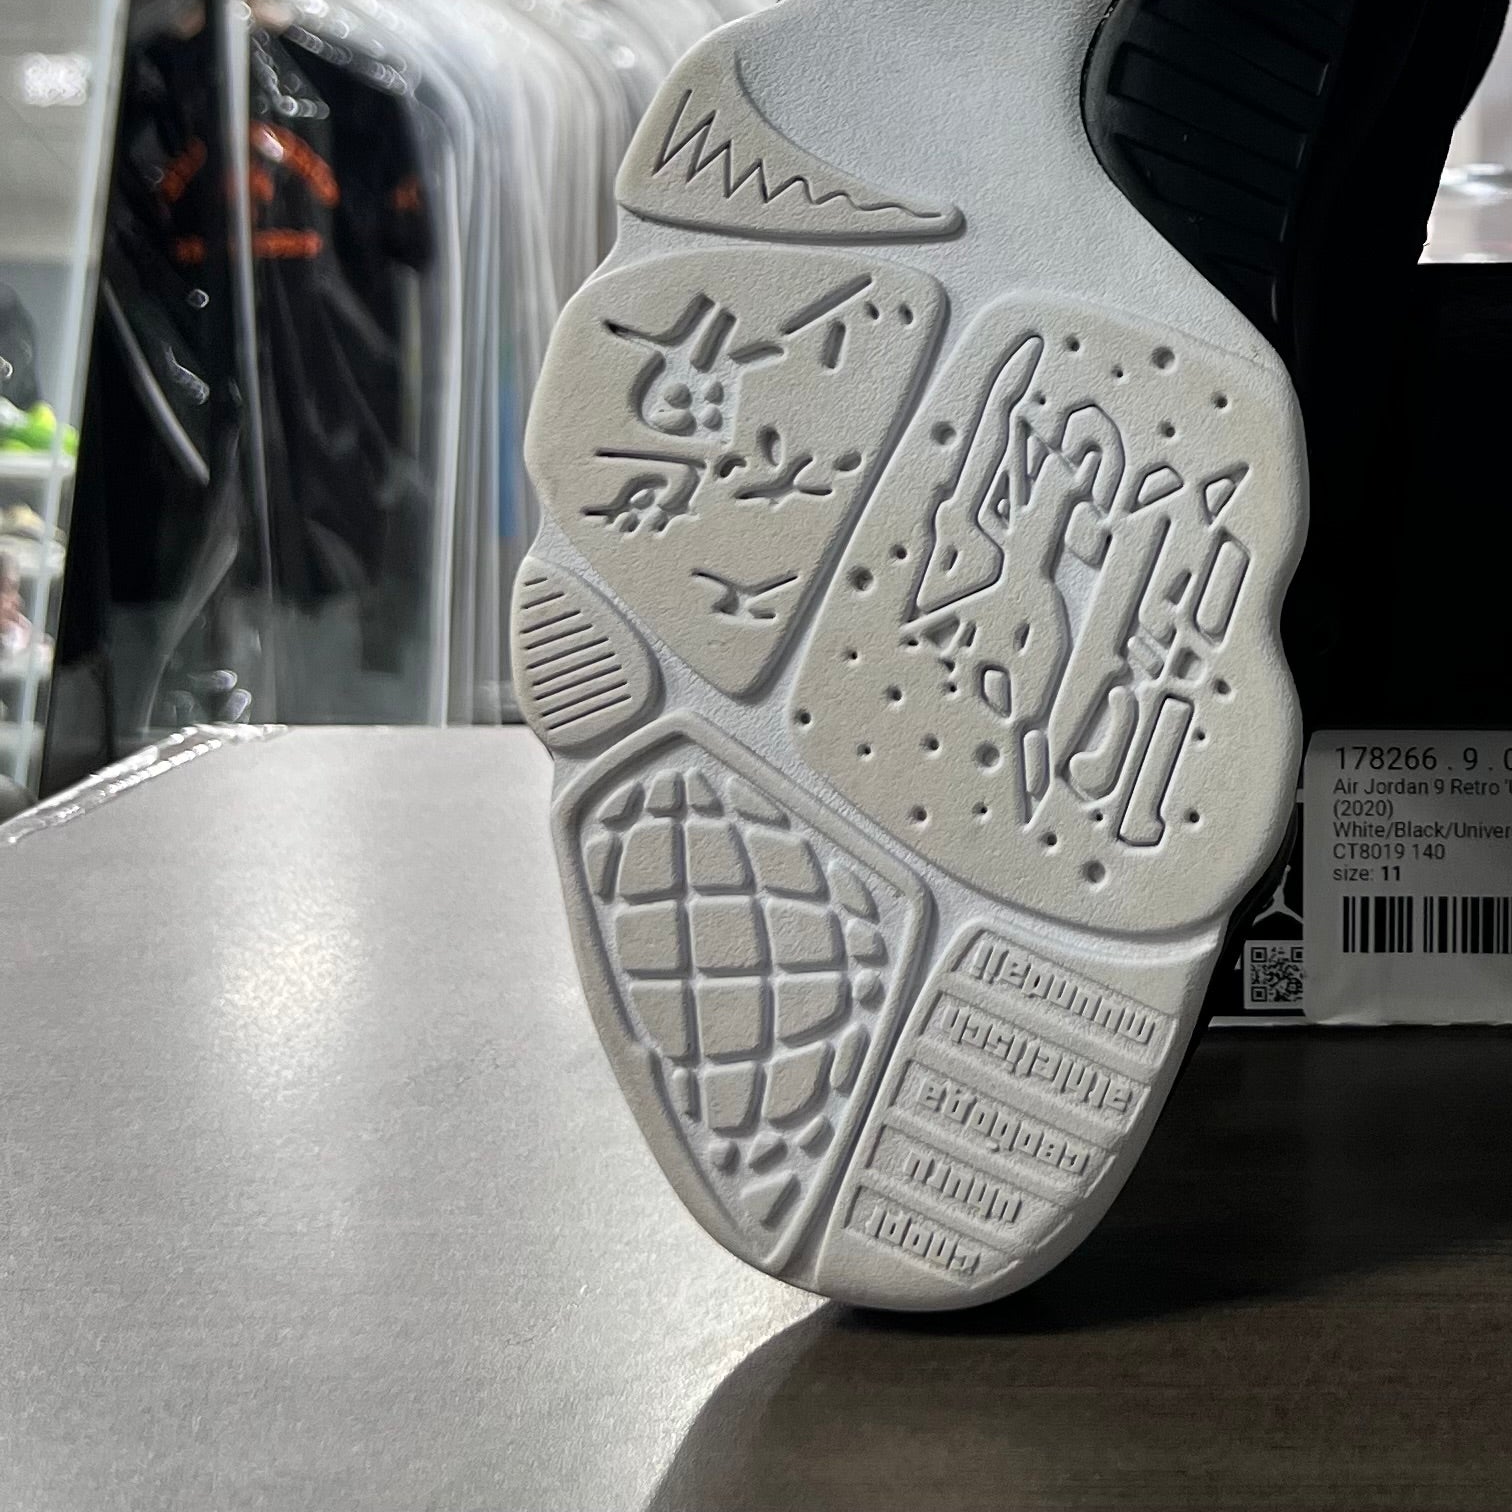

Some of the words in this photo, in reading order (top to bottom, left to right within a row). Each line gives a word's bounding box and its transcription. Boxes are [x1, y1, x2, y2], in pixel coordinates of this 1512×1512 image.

[1335, 746, 1438, 771] 178266
[1462, 746, 1479, 772] 9
[1333, 777, 1358, 796] Air
[1363, 777, 1430, 796] Jordan
[1433, 778, 1445, 796] 9
[1450, 778, 1500, 796] Retro
[1333, 798, 1394, 820] (2020)
[1333, 842, 1406, 860] CT8019
[1412, 842, 1446, 860] 140
[1333, 865, 1374, 882] size:
[1381, 865, 1401, 882] 11
